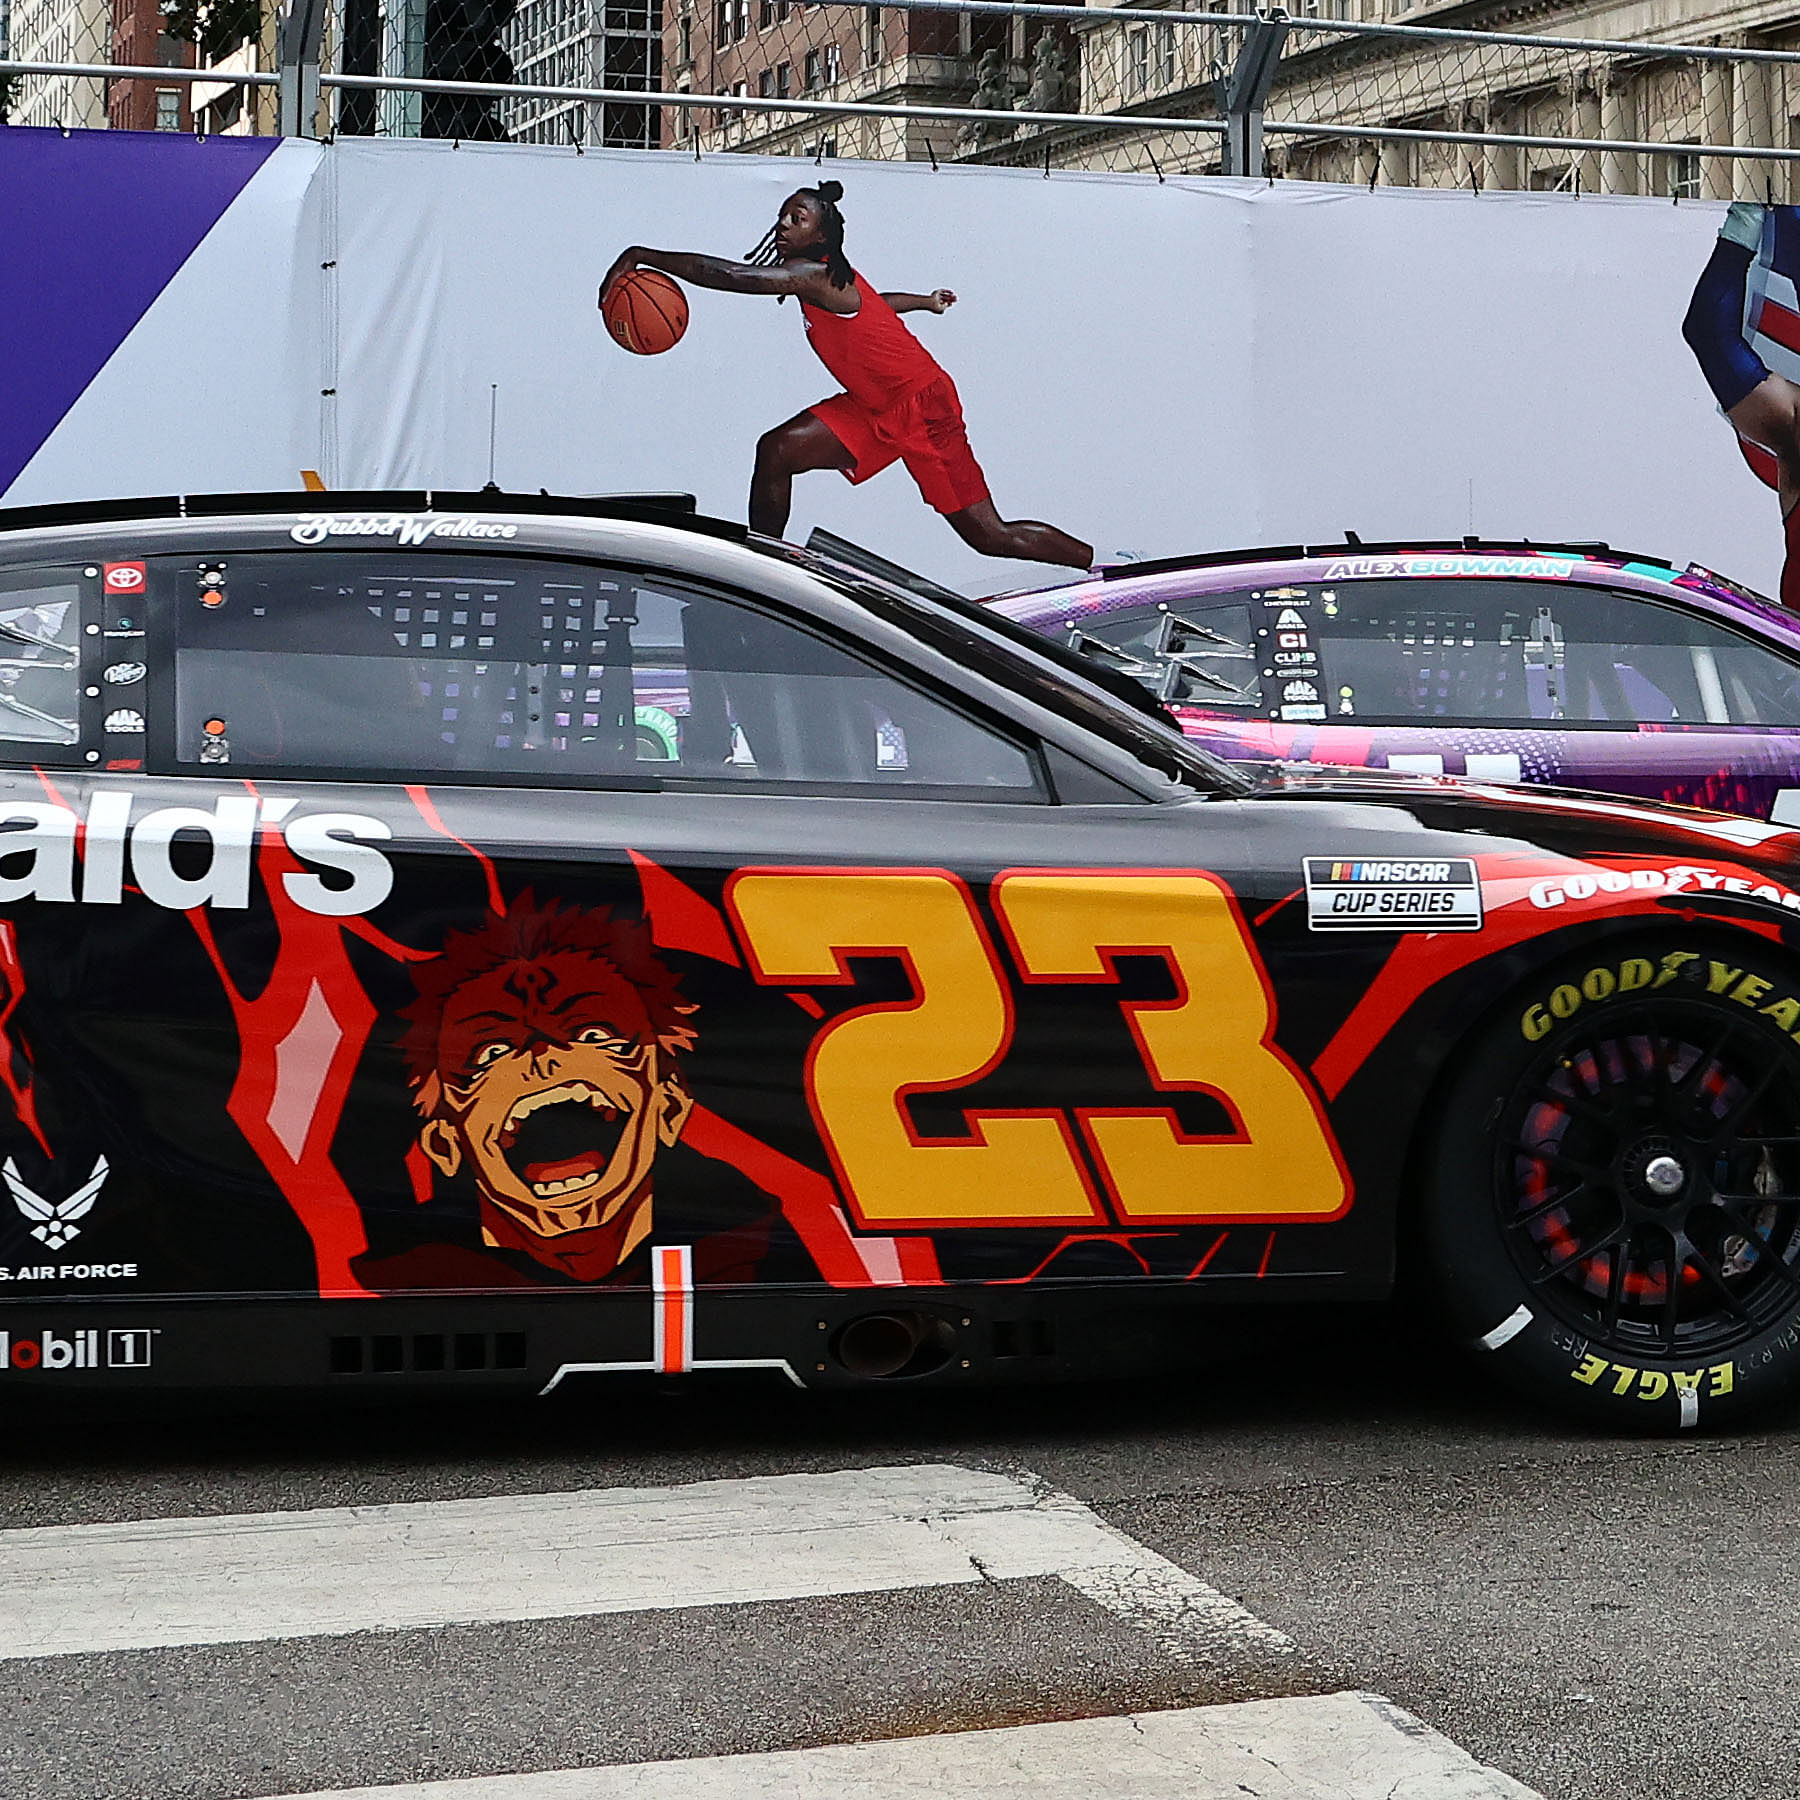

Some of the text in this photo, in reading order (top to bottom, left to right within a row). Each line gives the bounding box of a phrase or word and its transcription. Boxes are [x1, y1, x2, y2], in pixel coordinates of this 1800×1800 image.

[290, 513, 519, 546] Bubba Wallace
[1322, 559, 1575, 579] ALEX BOWMAN
[1360, 863, 1451, 882] NASCAR
[1332, 892, 1455, 913] CUP SERIES
[722, 865, 1354, 1226] 23
[16, 1266, 56, 1281] AIR
[58, 1263, 138, 1279] FORCE
[1570, 1352, 1734, 1401] EAGLE
